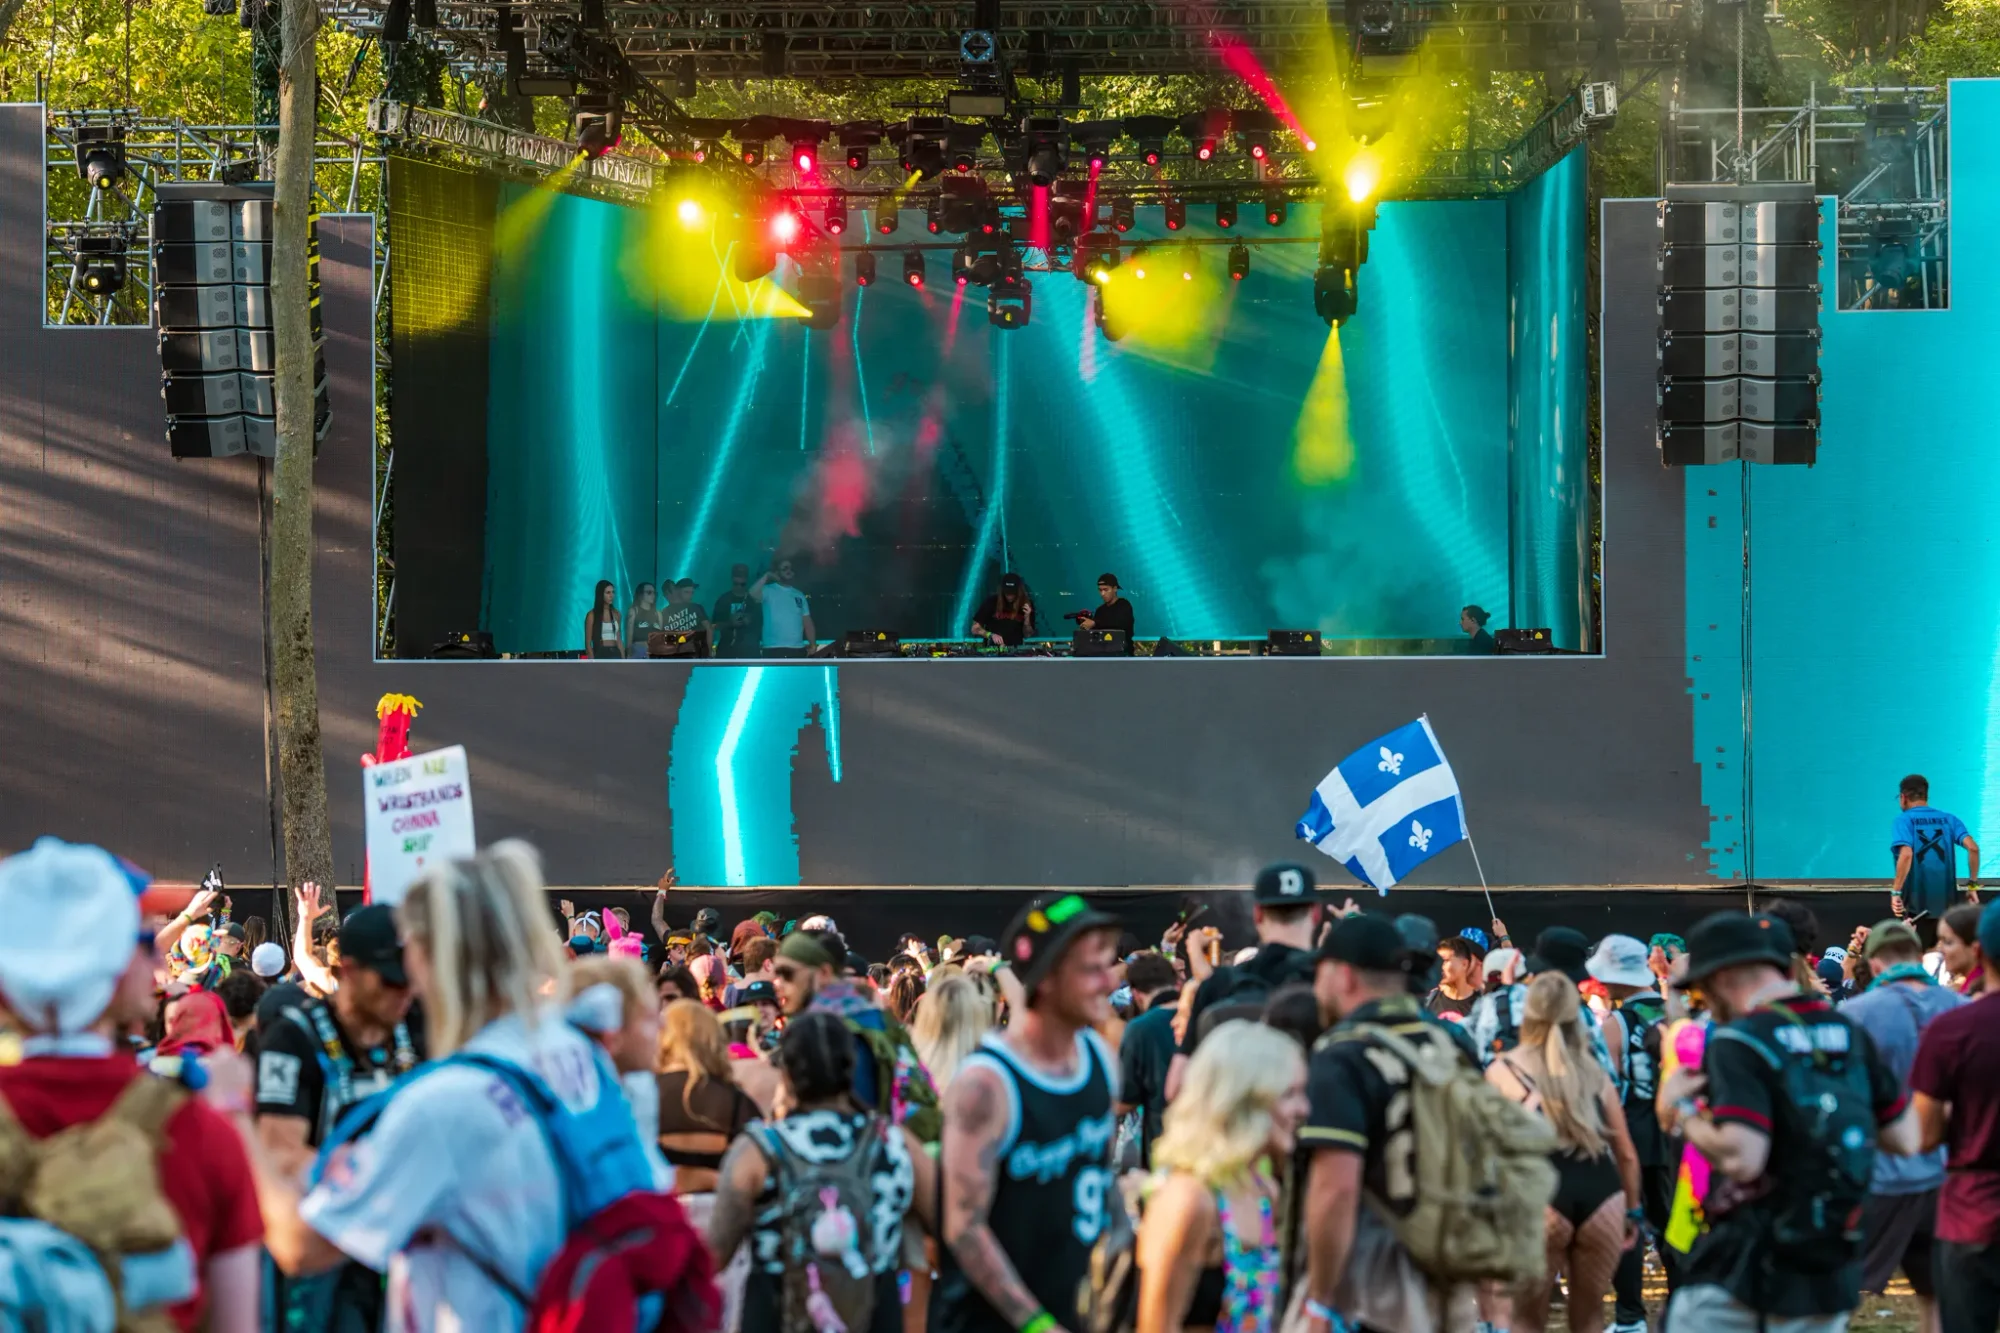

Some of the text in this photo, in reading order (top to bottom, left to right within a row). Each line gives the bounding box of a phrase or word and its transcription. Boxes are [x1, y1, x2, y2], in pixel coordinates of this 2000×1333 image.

[664, 612, 697, 630] RIDDIM
[668, 608, 688, 622] ANTI
[378, 783, 463, 812] WRISTBANDS
[1279, 868, 1304, 896] D
